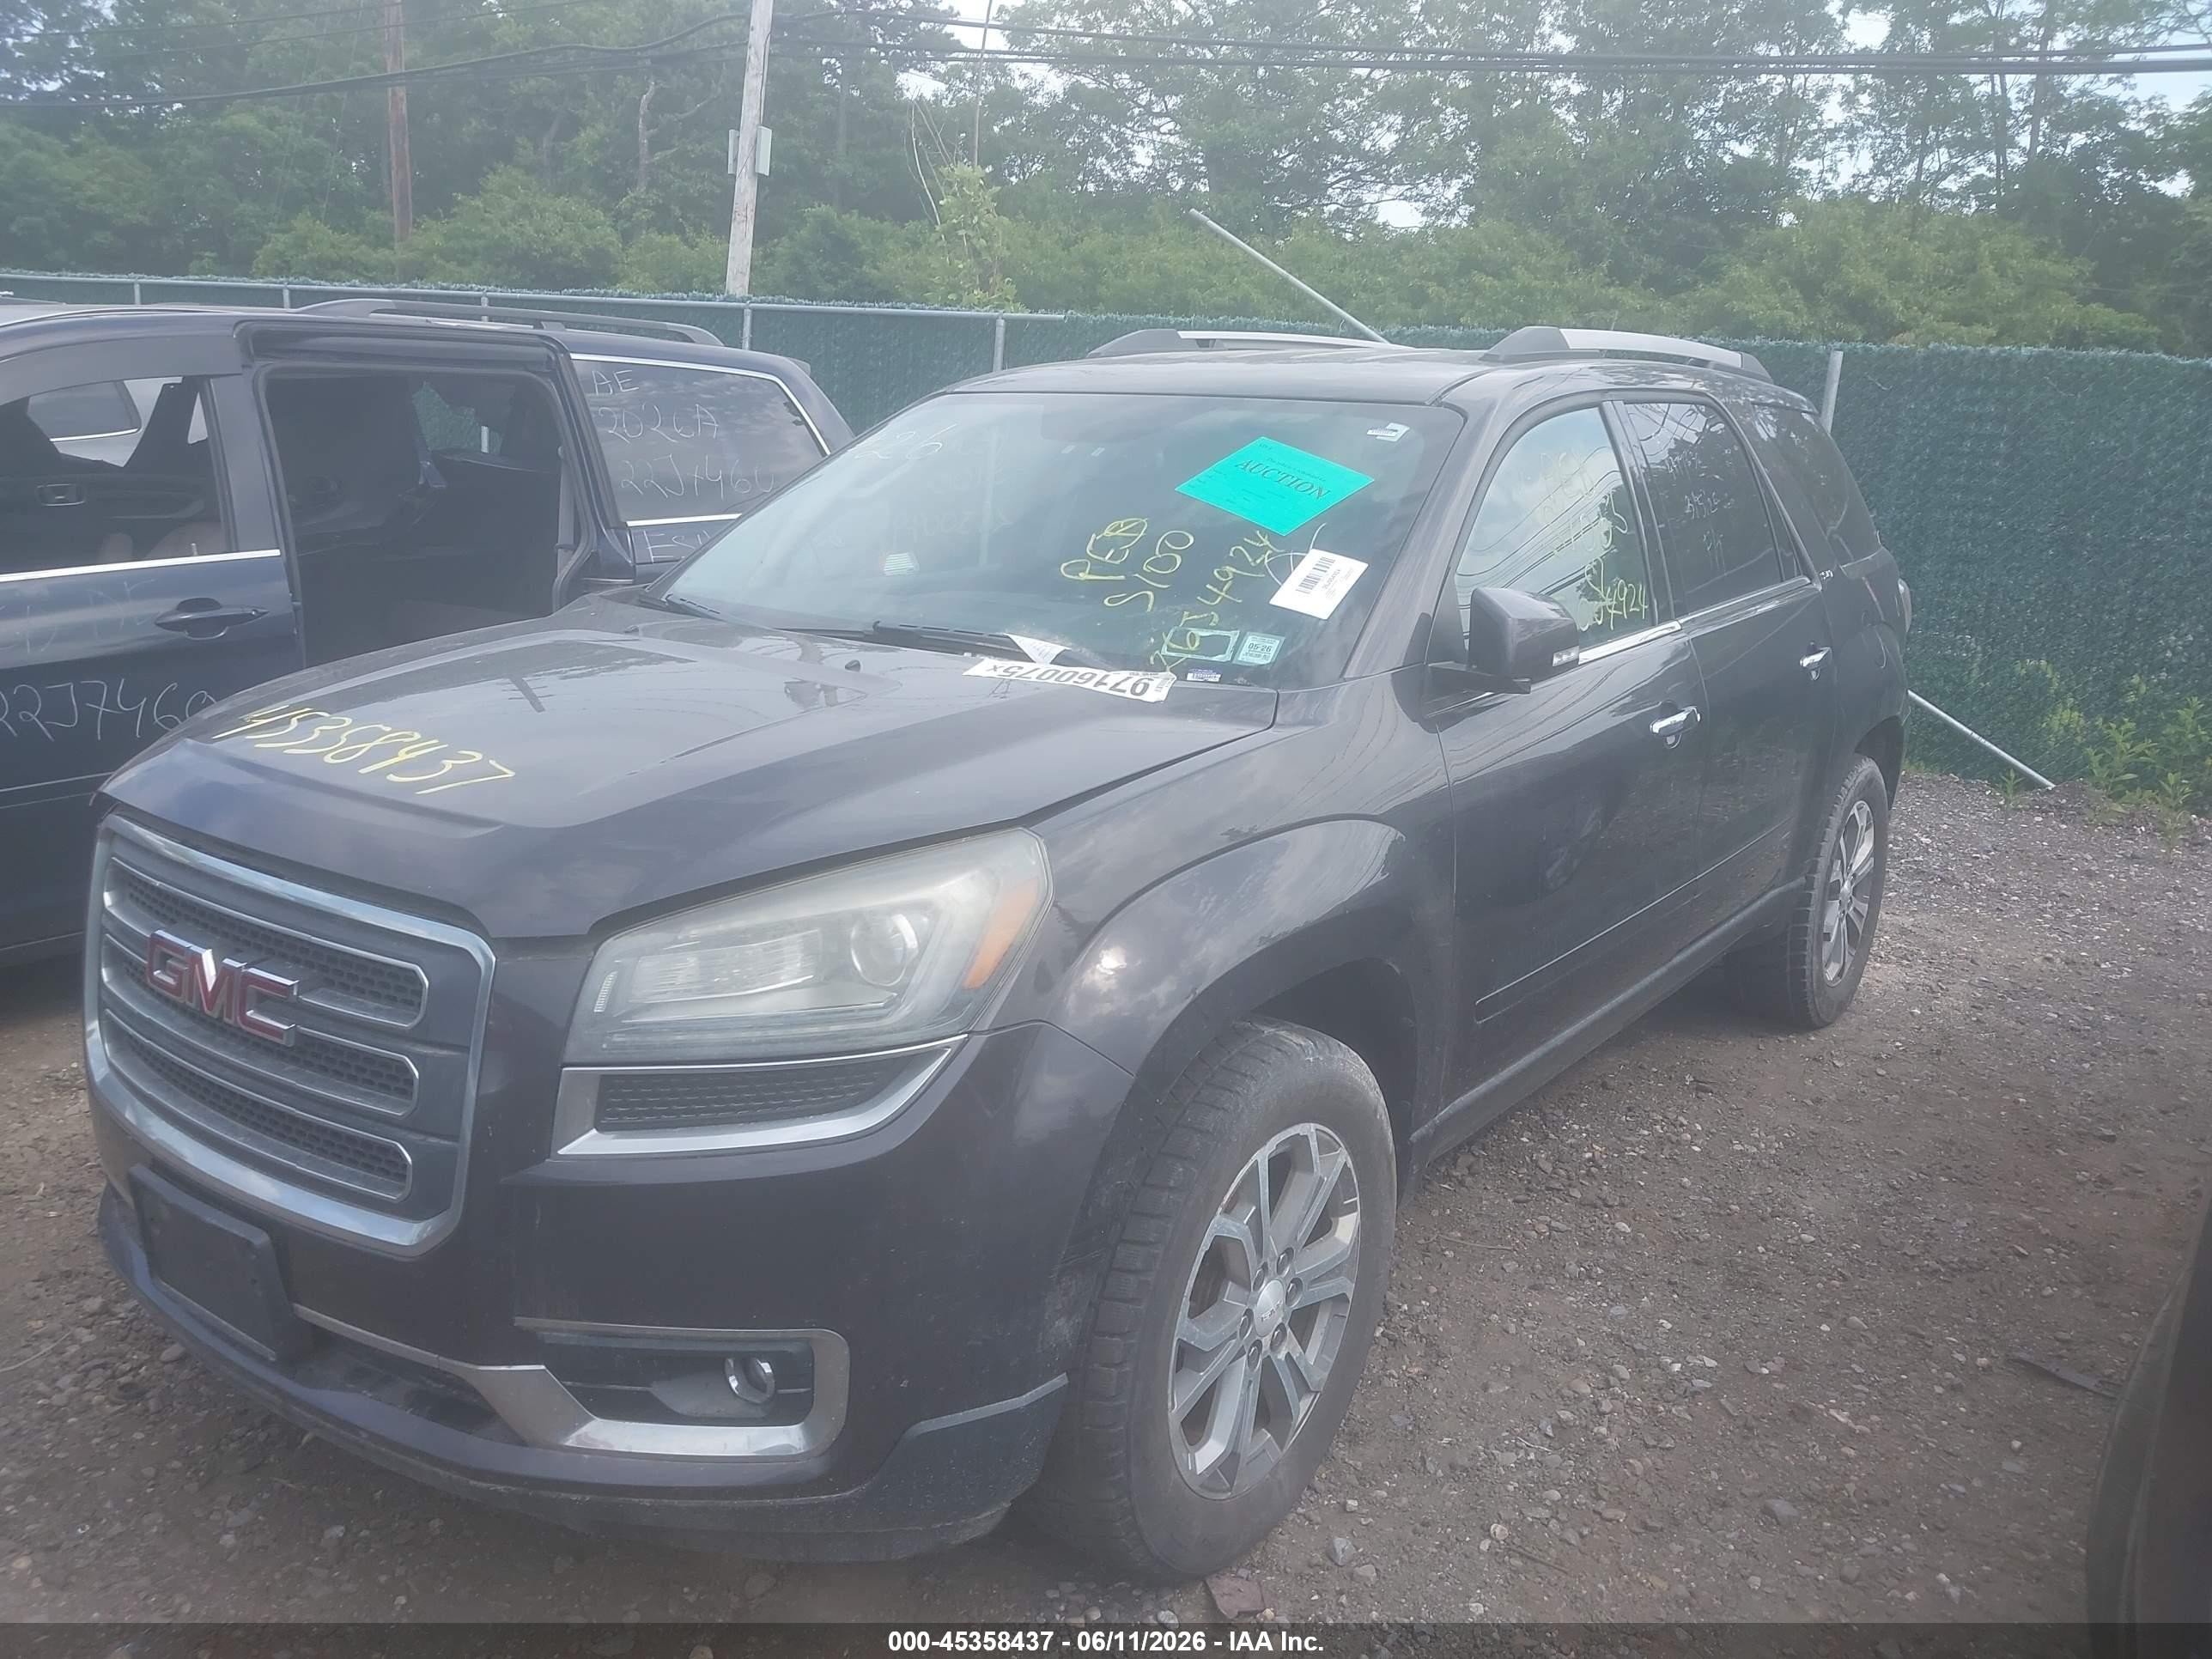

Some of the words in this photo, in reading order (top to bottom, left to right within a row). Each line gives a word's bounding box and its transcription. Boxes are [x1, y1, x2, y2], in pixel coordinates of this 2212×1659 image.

[1235, 459, 1330, 501] AUCTION
[1248, 642, 1272, 653] 05-26
[211, 705, 516, 794] 45358437
[147, 929, 300, 1048] GMC
